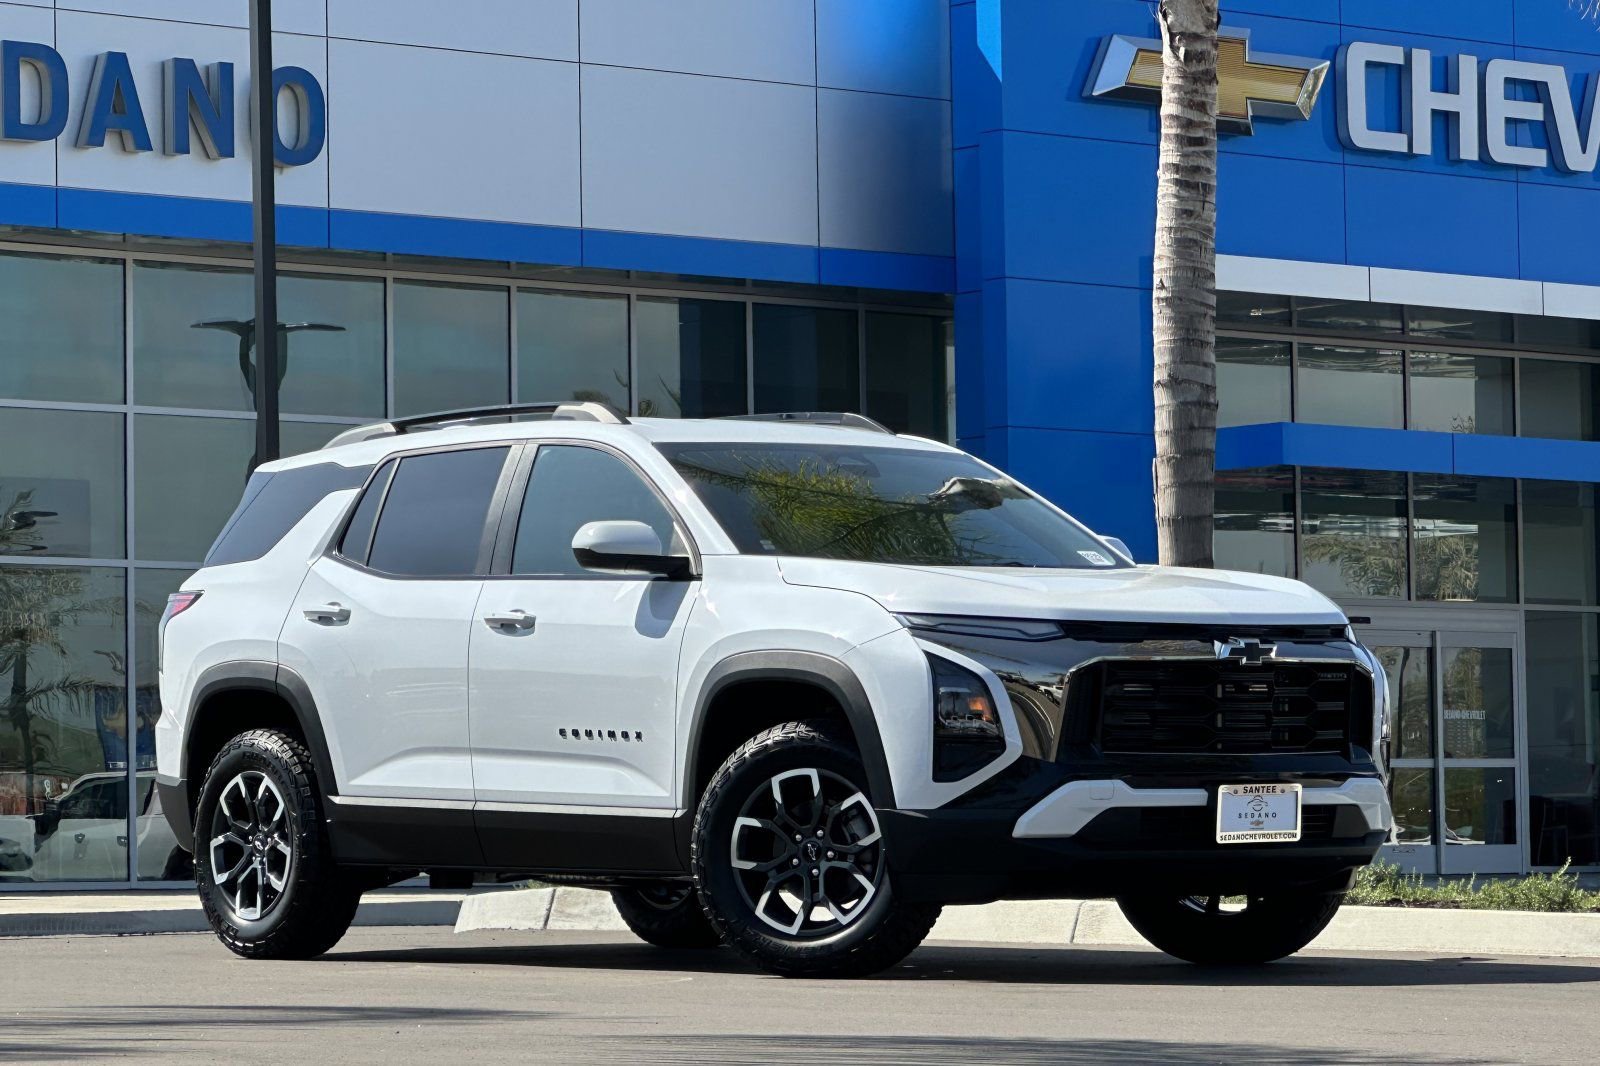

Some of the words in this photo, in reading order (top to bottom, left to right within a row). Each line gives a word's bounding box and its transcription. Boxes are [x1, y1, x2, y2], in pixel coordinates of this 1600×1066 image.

[1, 40, 326, 168] DANO
[1338, 41, 1600, 173] CHEV
[558, 728, 643, 740] EQUINOX
[1243, 785, 1277, 794] SANTEE
[1220, 832, 1297, 841] SEDANOCHEVROLET.COM
